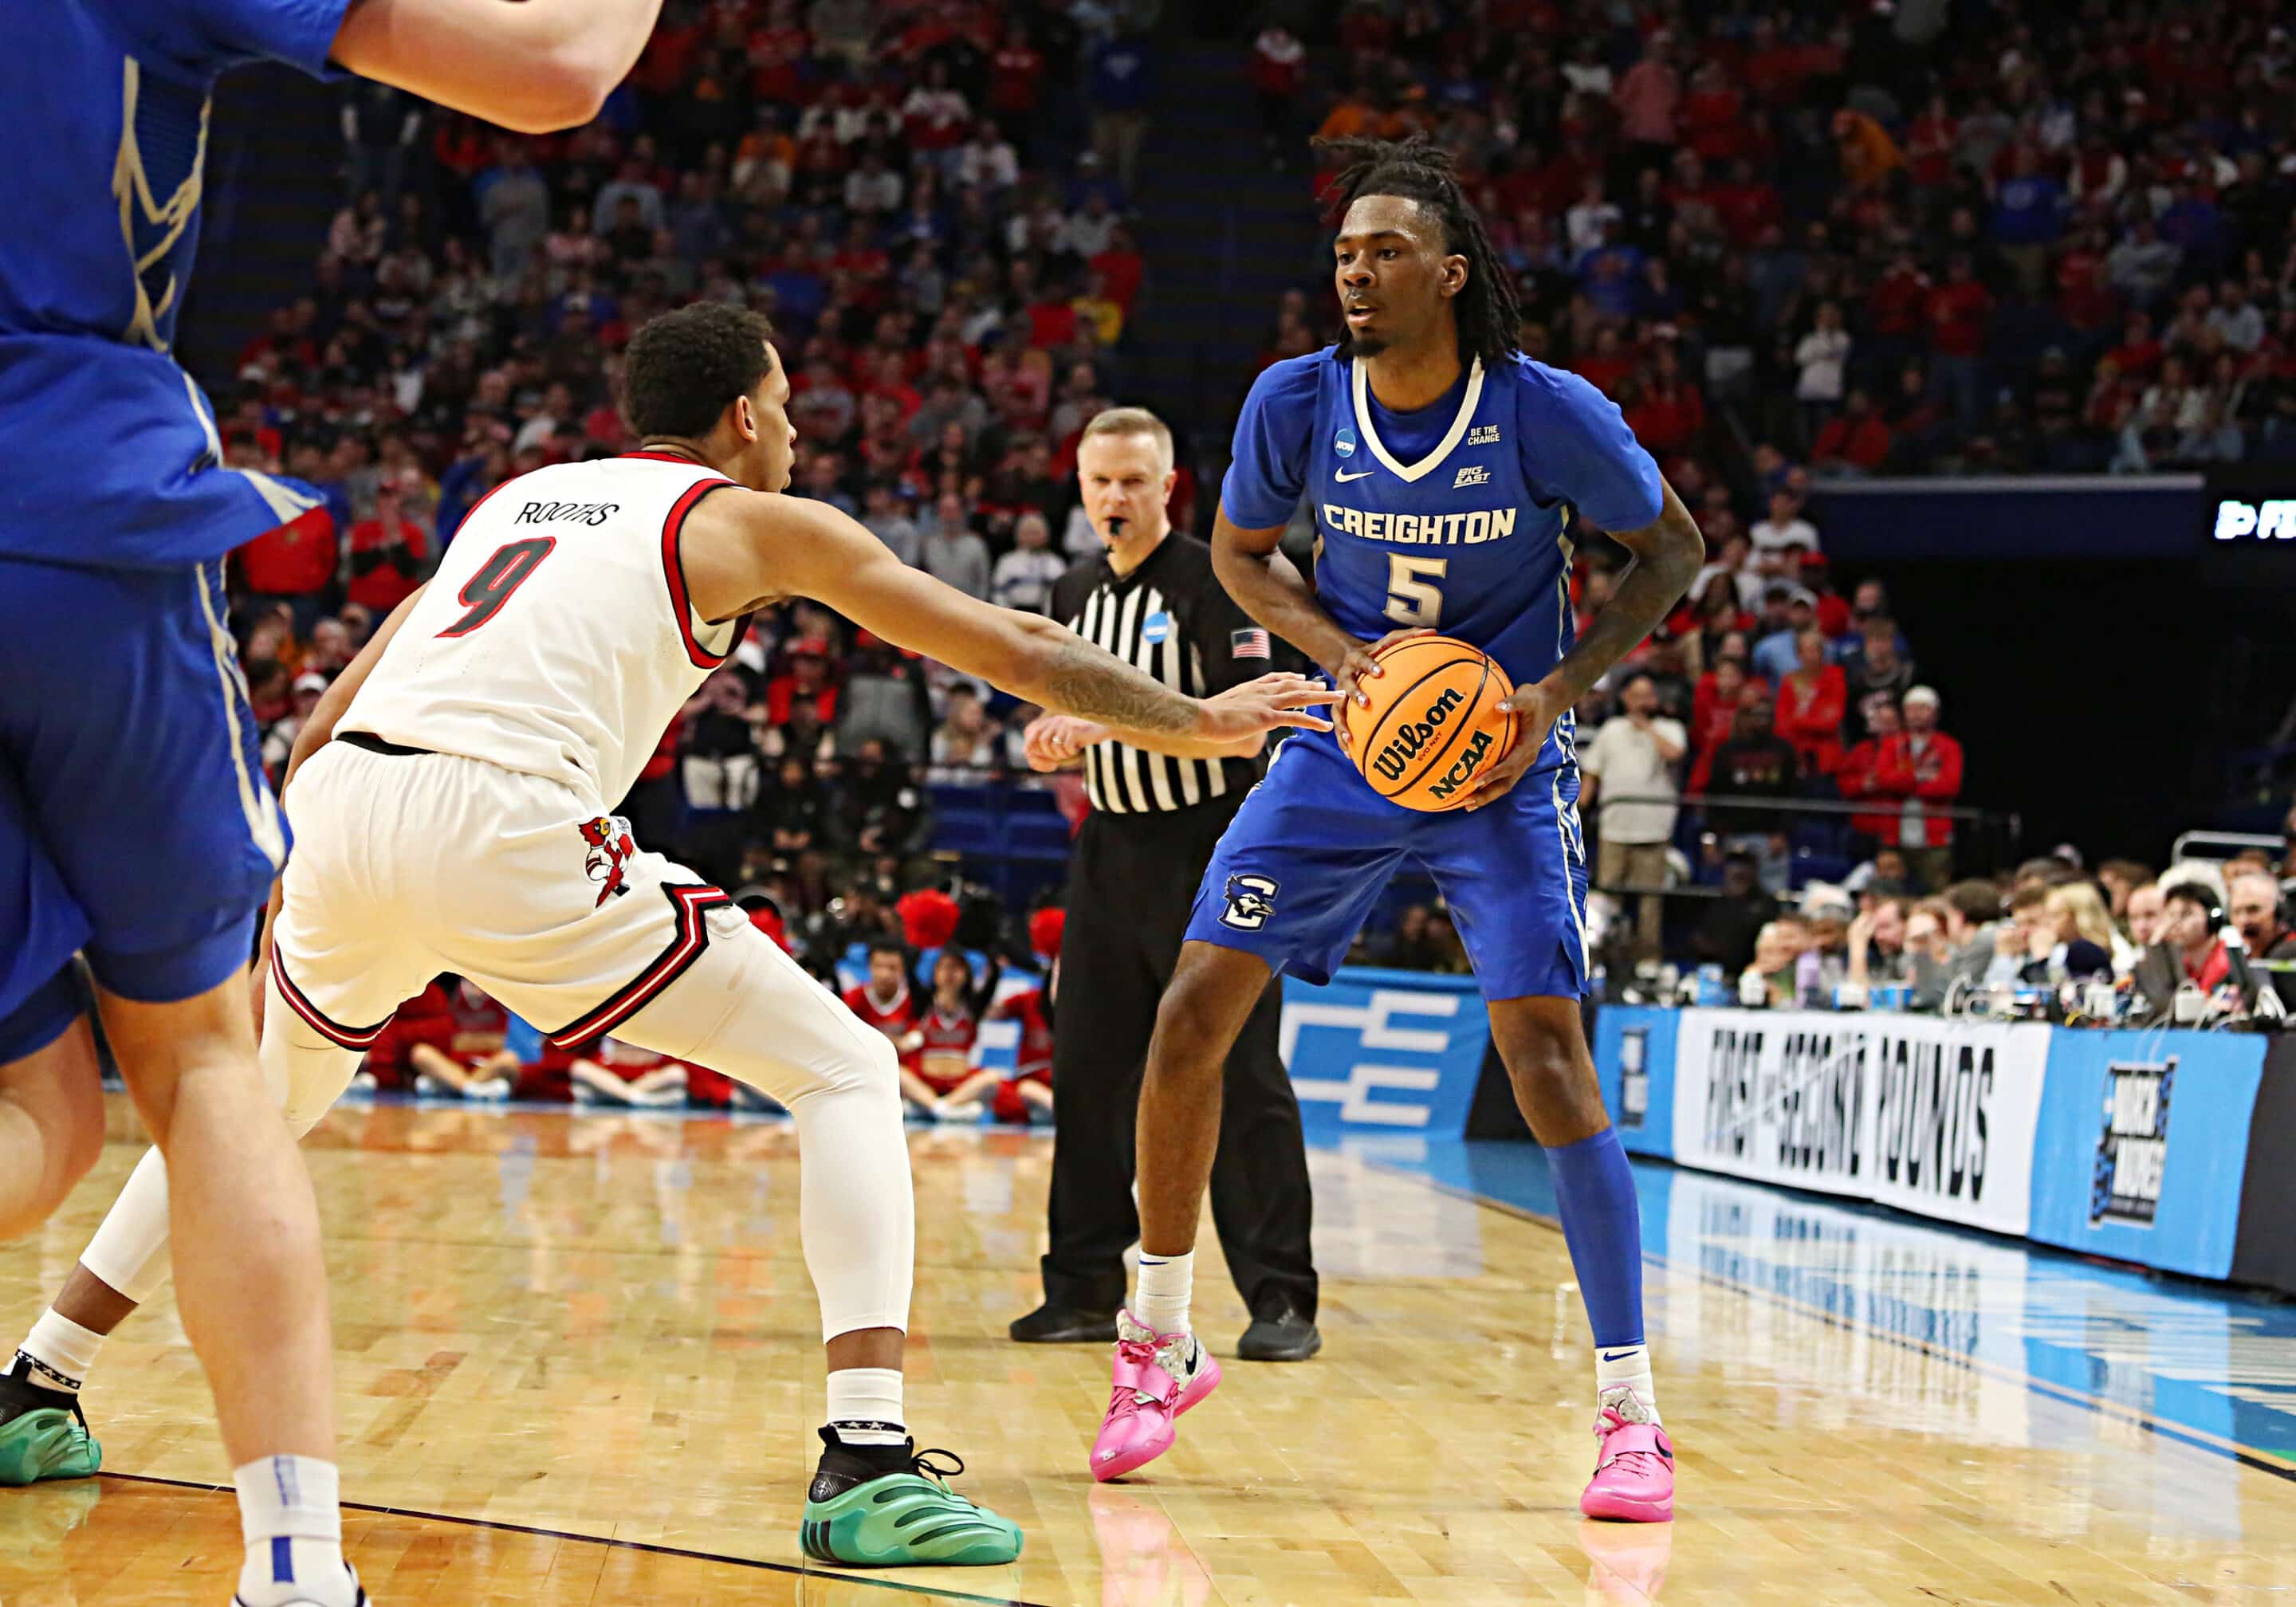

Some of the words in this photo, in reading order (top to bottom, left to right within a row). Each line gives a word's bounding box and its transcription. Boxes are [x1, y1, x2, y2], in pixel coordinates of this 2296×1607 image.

[1468, 433, 1500, 446] CHANGE
[1470, 427, 1482, 436] BE
[1484, 424, 1498, 435] THE
[1454, 472, 1491, 485] EAST
[1458, 466, 1484, 477] BIG
[514, 501, 619, 526] ROOTHS
[1323, 503, 1517, 544] CREIGHTON
[433, 536, 556, 638] 9
[1382, 552, 1448, 628] 5
[1372, 688, 1464, 780] Wilson
[1428, 729, 1493, 800] NCAA
